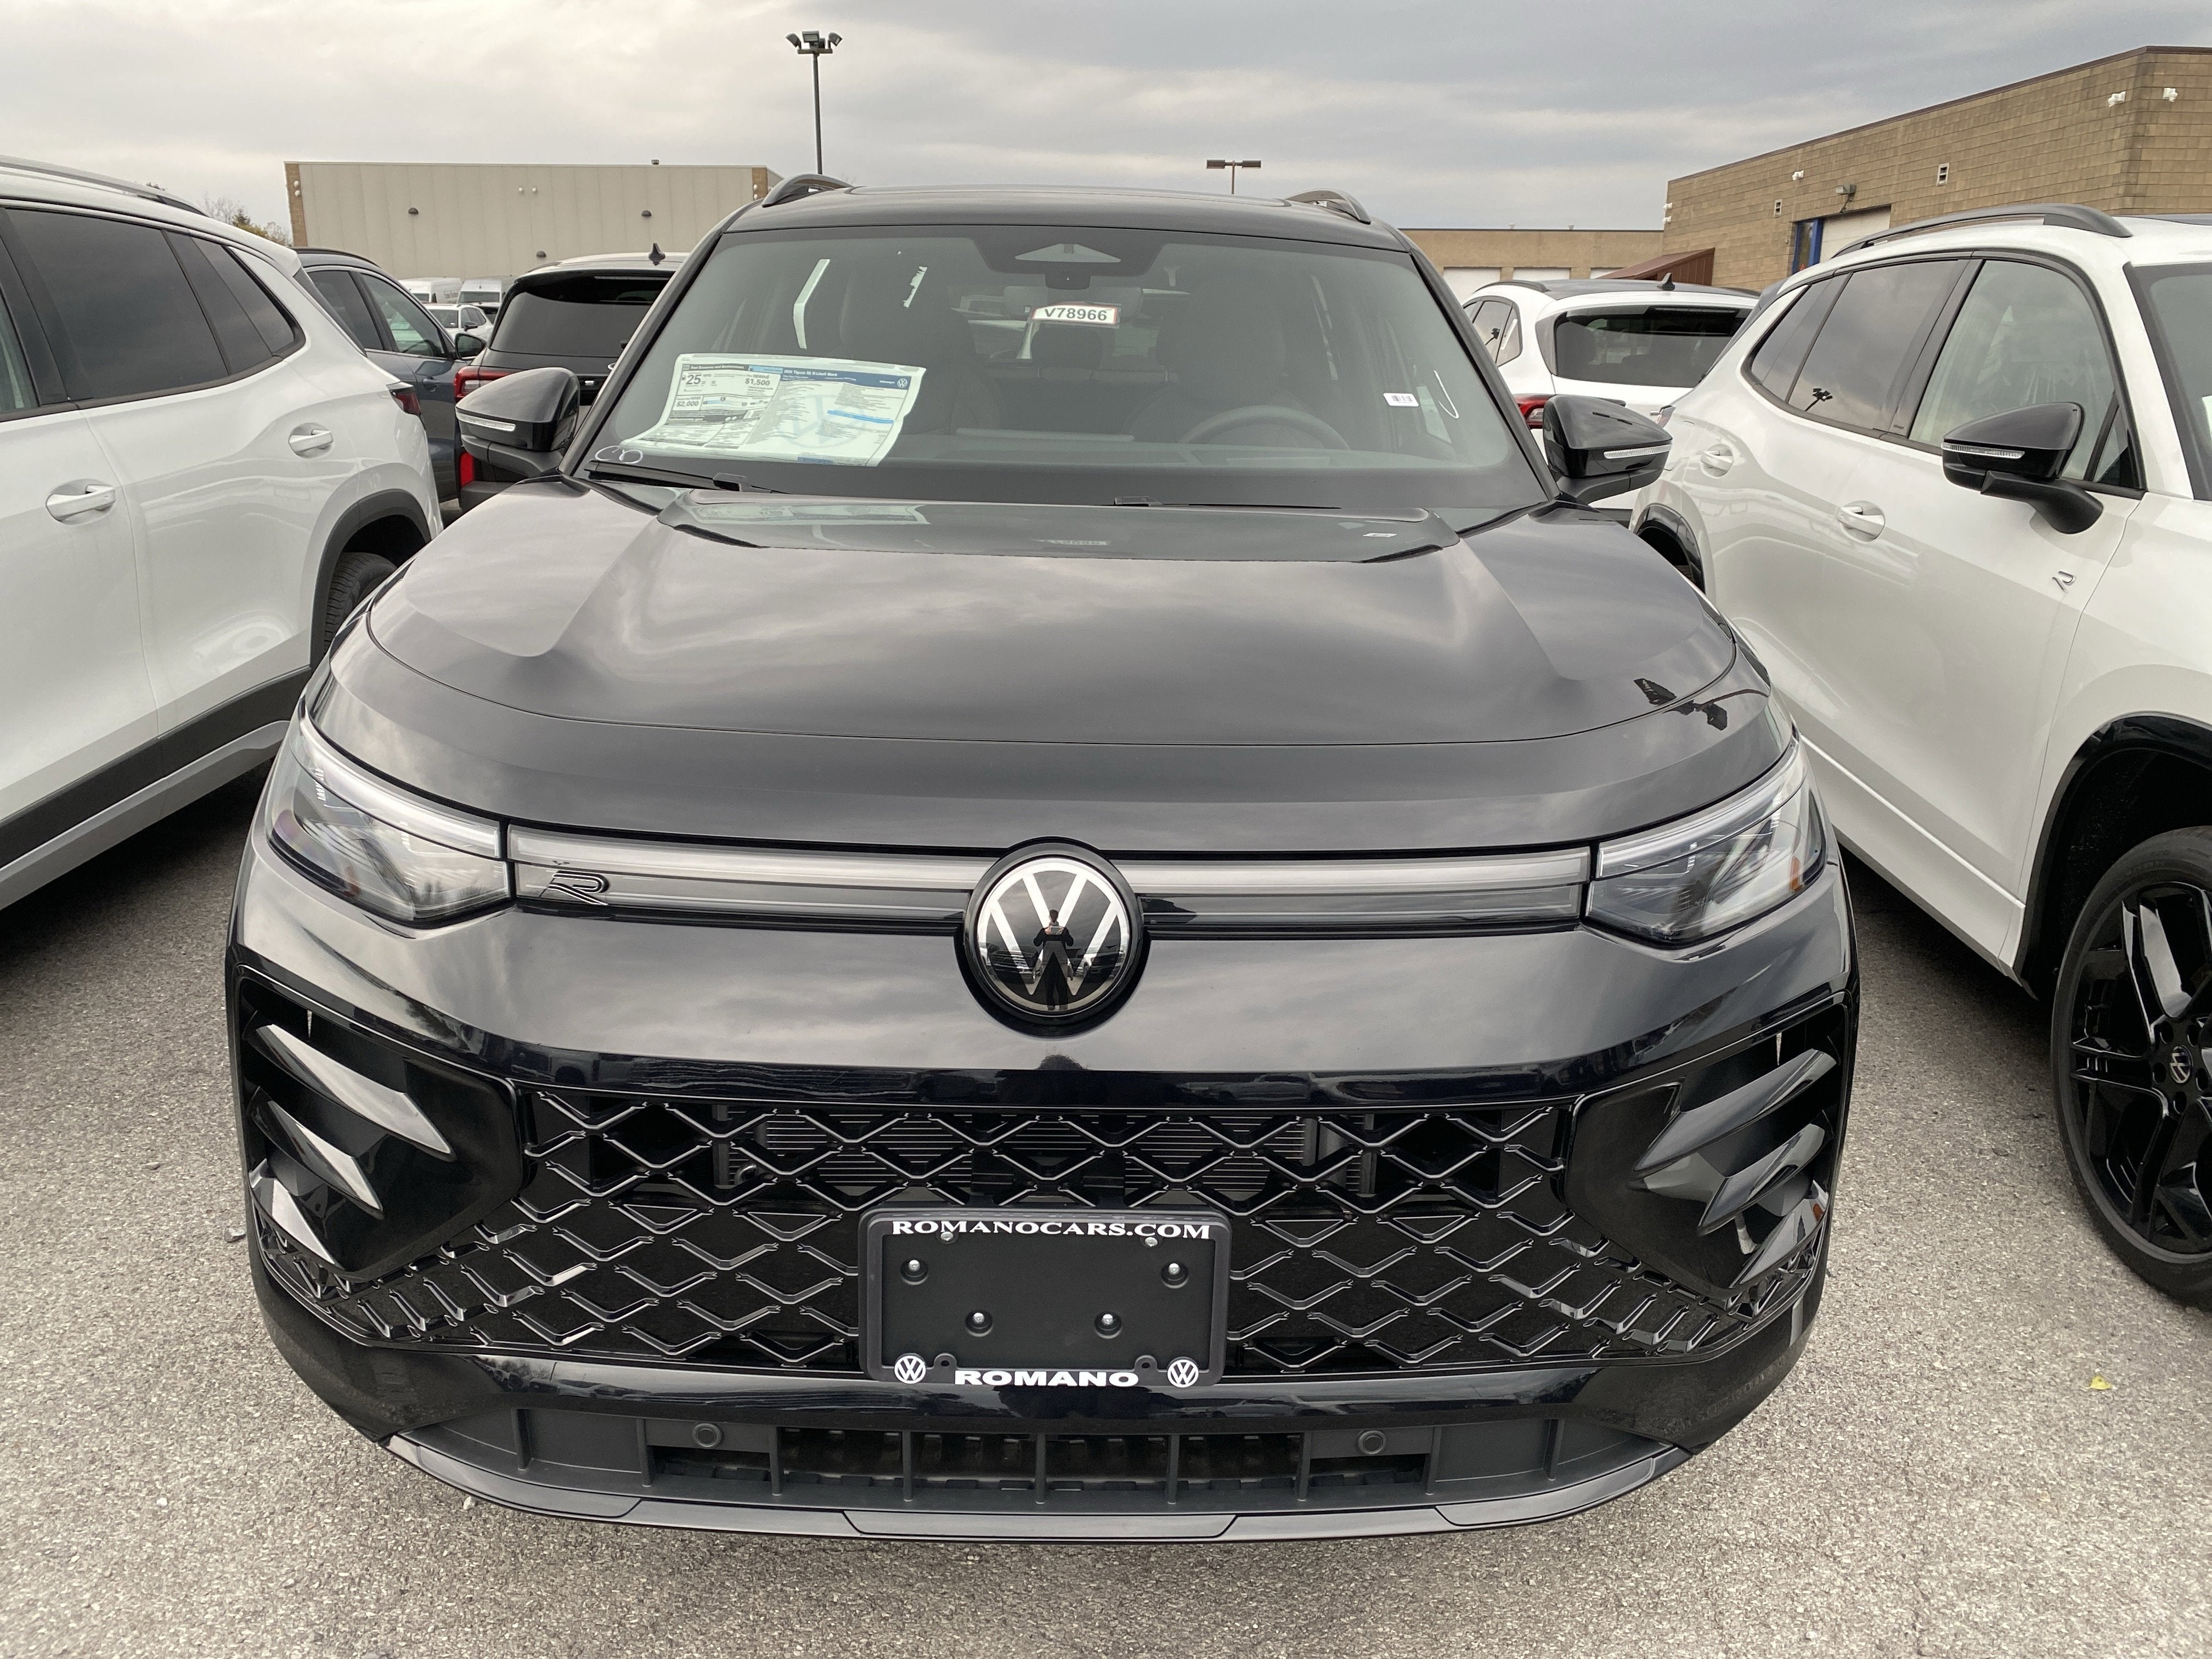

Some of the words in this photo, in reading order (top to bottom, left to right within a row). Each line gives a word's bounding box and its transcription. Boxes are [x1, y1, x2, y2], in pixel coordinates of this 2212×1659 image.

[1045, 308, 1107, 321] V78966
[686, 374, 702, 385] 25
[745, 378, 770, 386] $1,500
[891, 1221, 1210, 1239] ROMANOCARS.COM
[954, 1370, 1139, 1387] ROMANO
